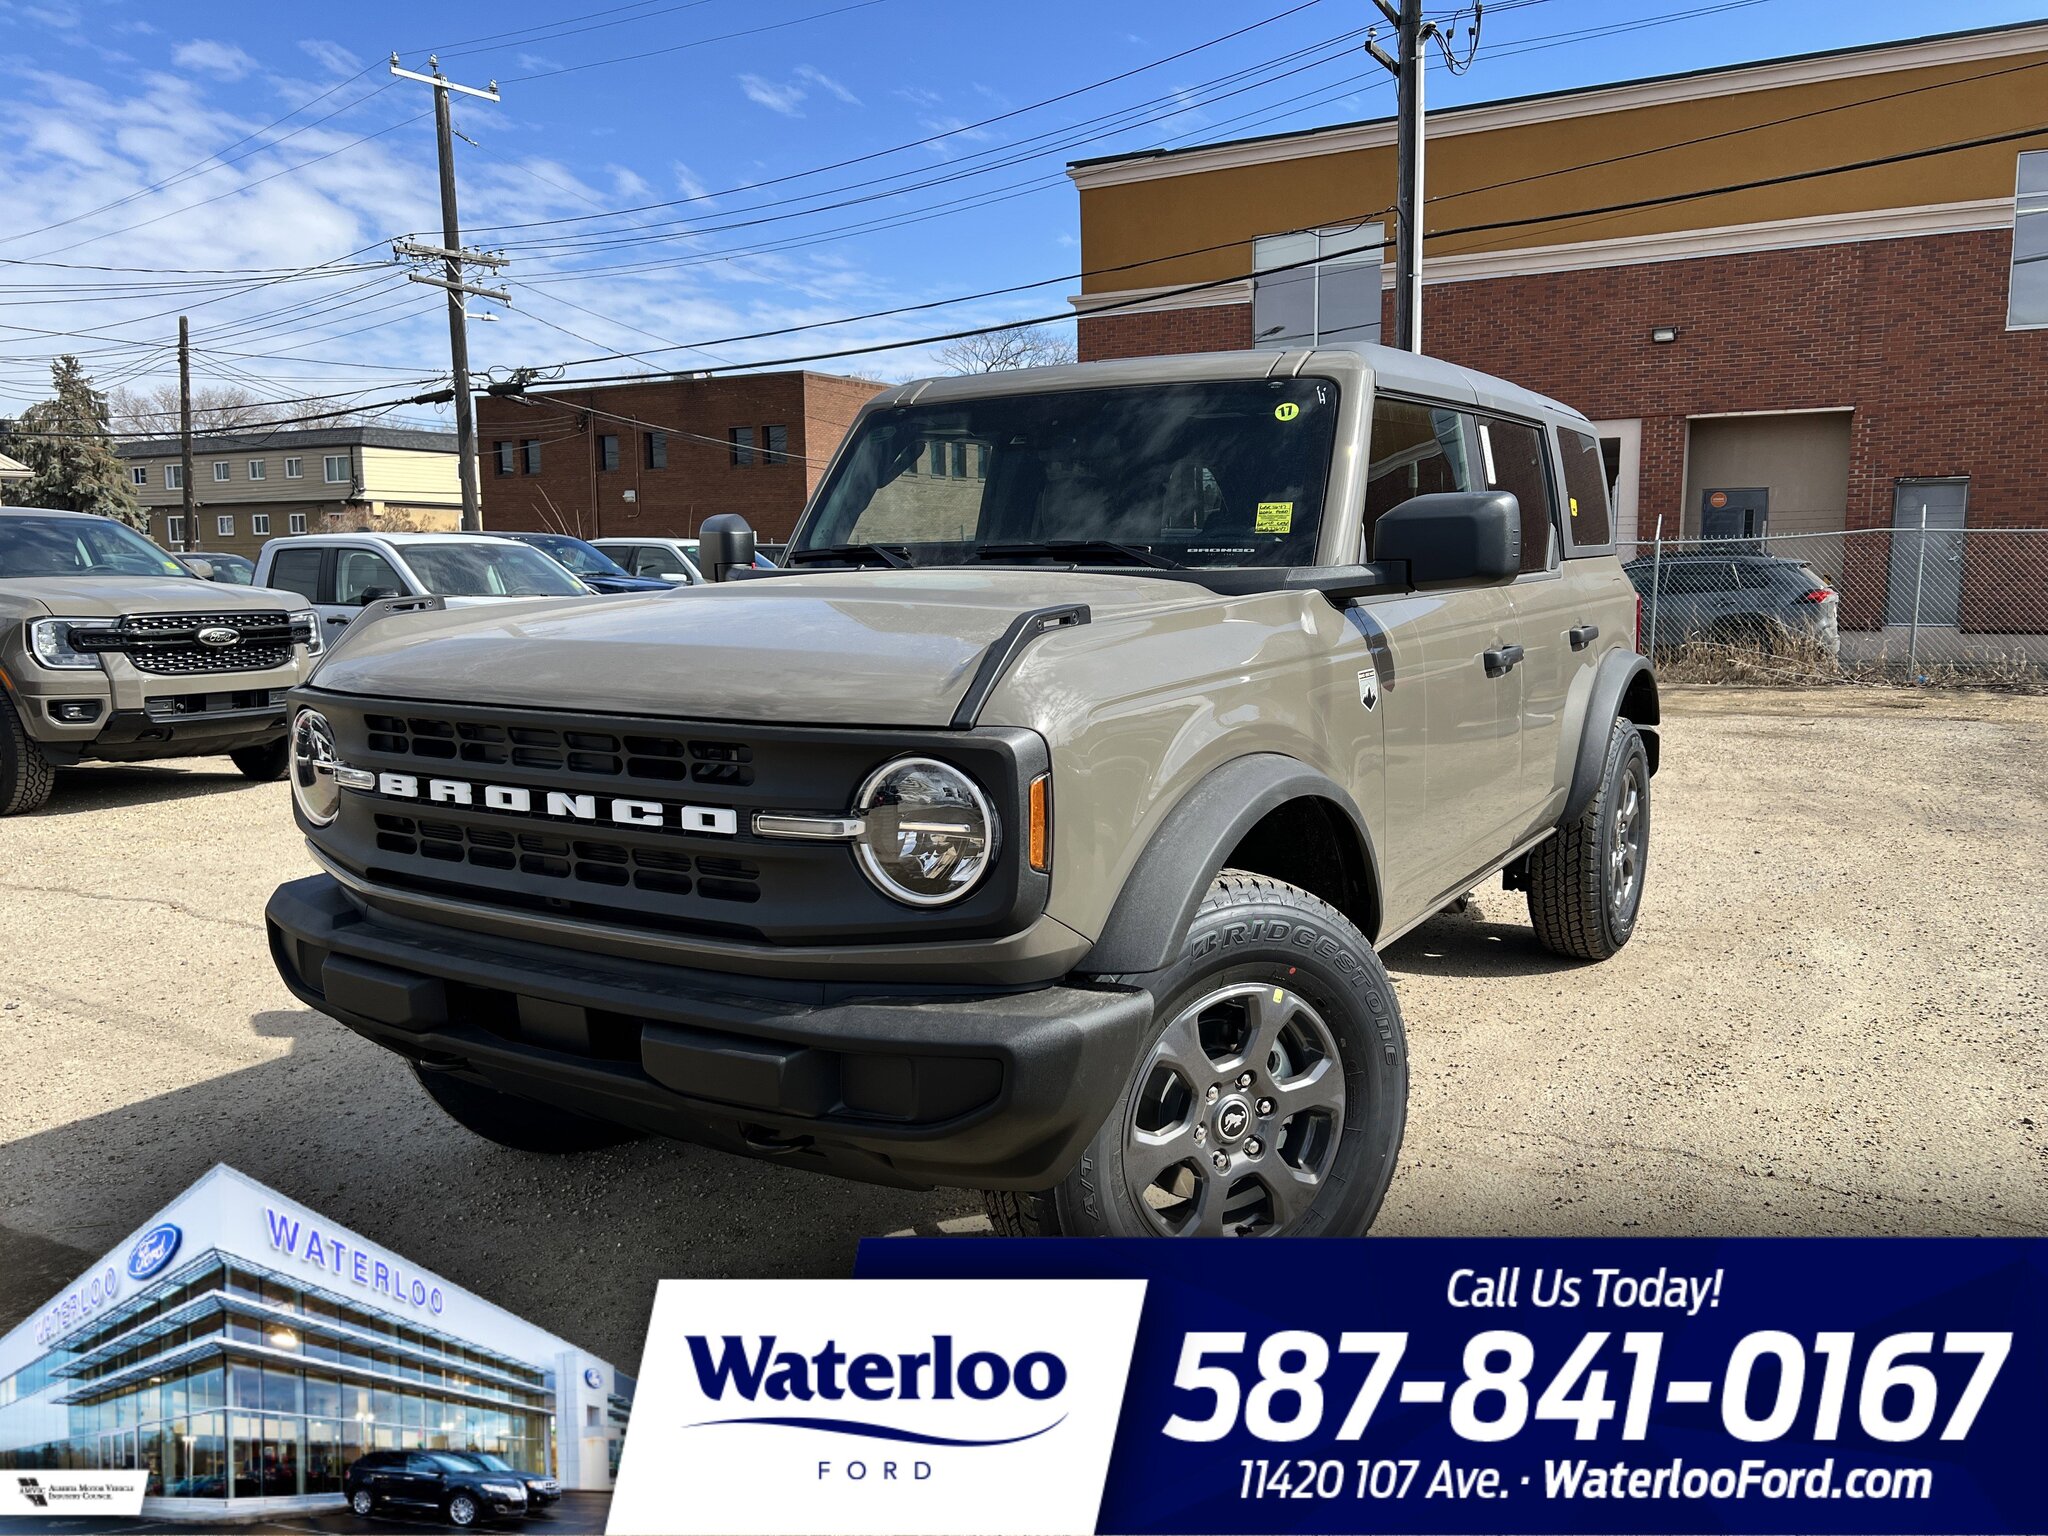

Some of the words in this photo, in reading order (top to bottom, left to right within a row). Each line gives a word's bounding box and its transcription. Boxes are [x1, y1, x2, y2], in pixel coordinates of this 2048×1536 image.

[1278, 405, 1293, 417] 17
[378, 771, 738, 835] BRONCO
[1190, 919, 1399, 1067] BRIDGESTONE
